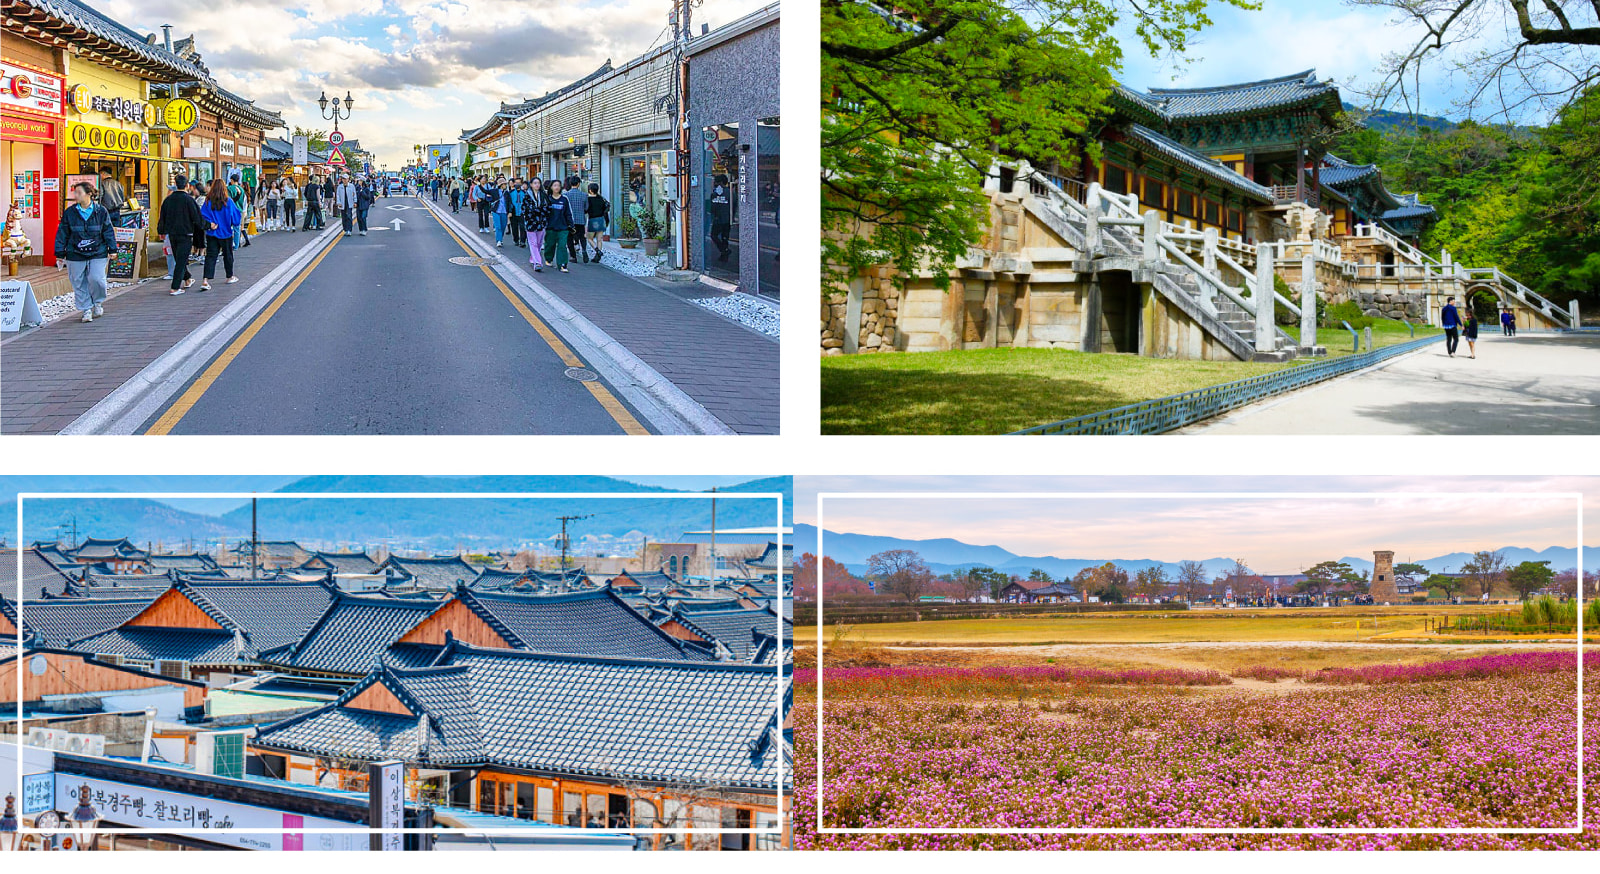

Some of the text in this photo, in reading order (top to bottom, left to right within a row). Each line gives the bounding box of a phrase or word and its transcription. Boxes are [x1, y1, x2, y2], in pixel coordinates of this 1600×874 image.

[95, 96, 112, 112] 경주
[178, 106, 192, 125] 10
[30, 124, 46, 132] world
